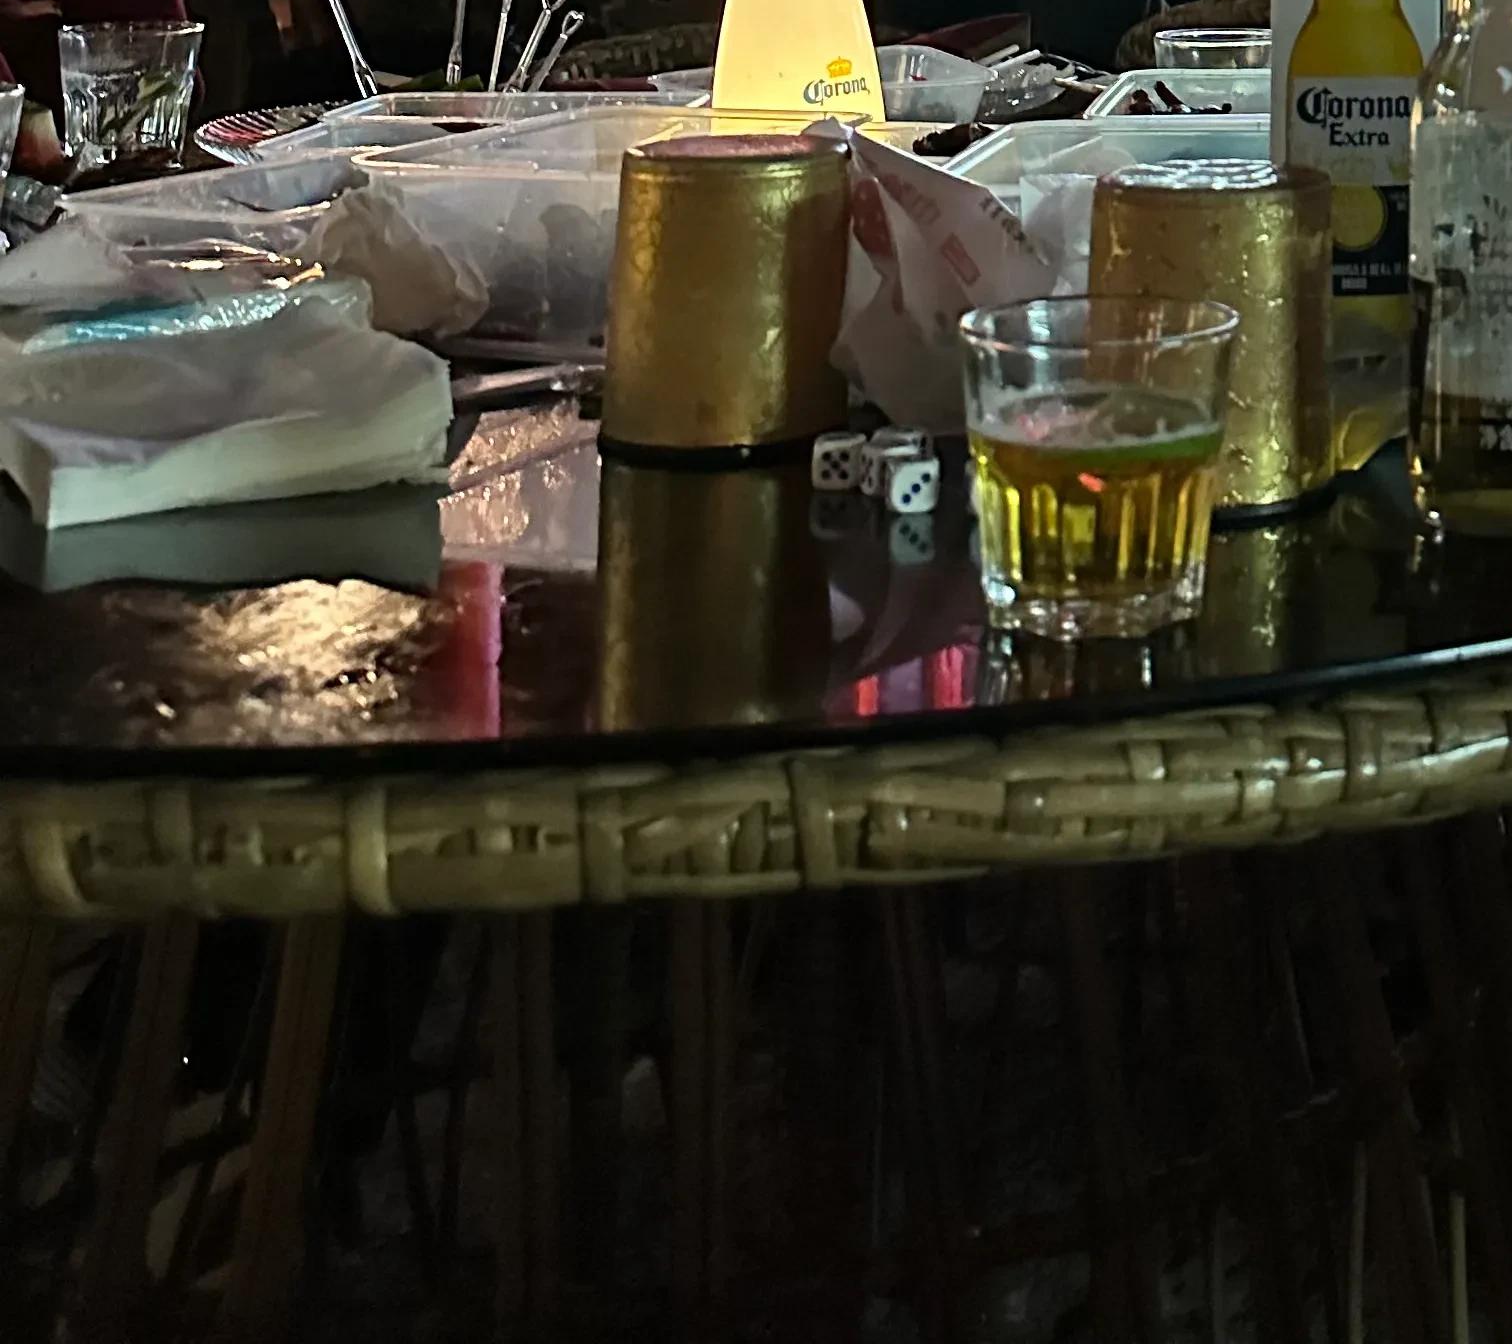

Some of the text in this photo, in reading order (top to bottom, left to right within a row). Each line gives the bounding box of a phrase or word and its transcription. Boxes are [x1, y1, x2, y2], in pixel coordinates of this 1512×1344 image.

[803, 77, 871, 106] Corona
[1296, 86, 1411, 130] Corona
[1328, 122, 1391, 147] Extra
